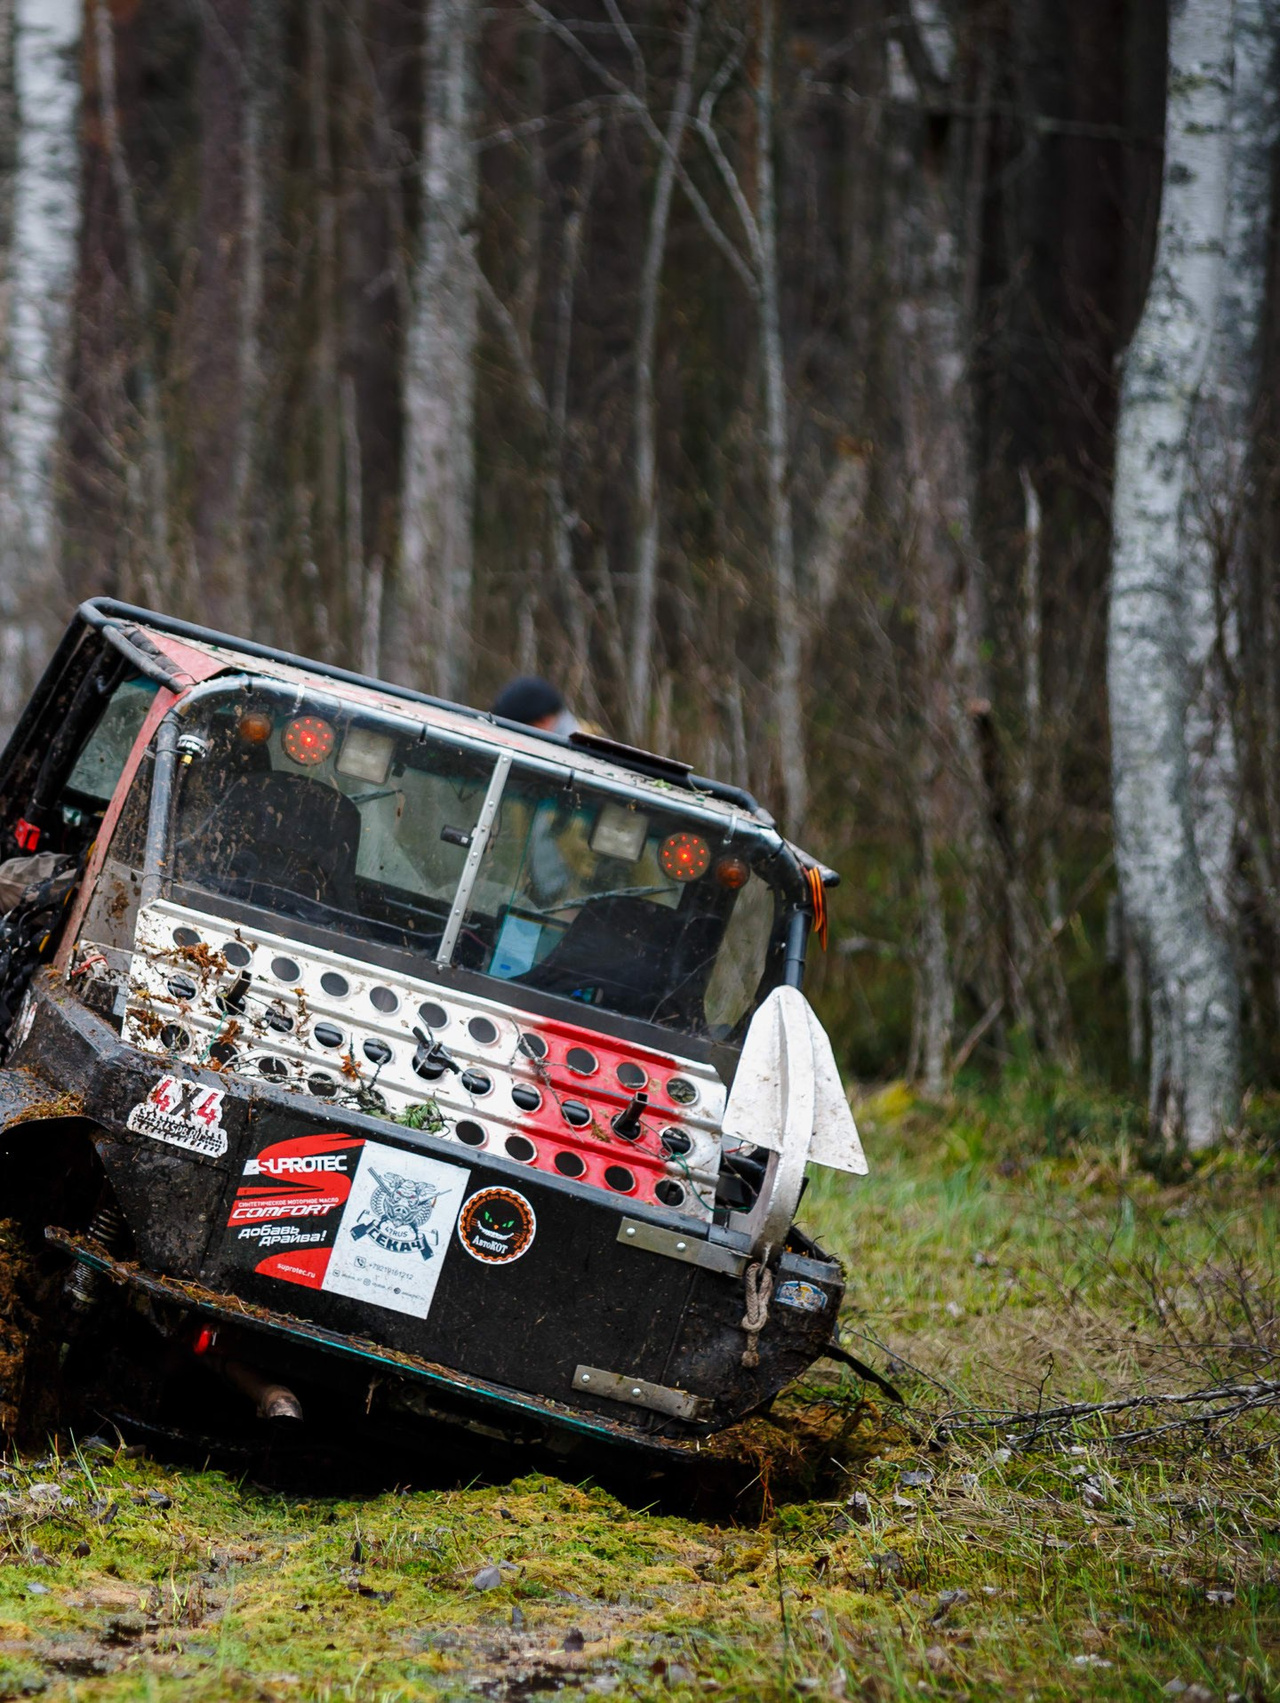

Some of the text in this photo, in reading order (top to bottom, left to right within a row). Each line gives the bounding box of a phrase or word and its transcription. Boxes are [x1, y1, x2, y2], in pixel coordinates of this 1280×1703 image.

[151, 1079, 219, 1125] 4X4
[243, 1155, 347, 1175] SUPROTEC
[231, 1203, 336, 1219] COMFORT
[237, 1224, 300, 1240] добавь
[258, 1230, 327, 1247] драйва!
[367, 1227, 422, 1252] СЕКАЧ
[277, 1263, 316, 1278] suprotec.ru
